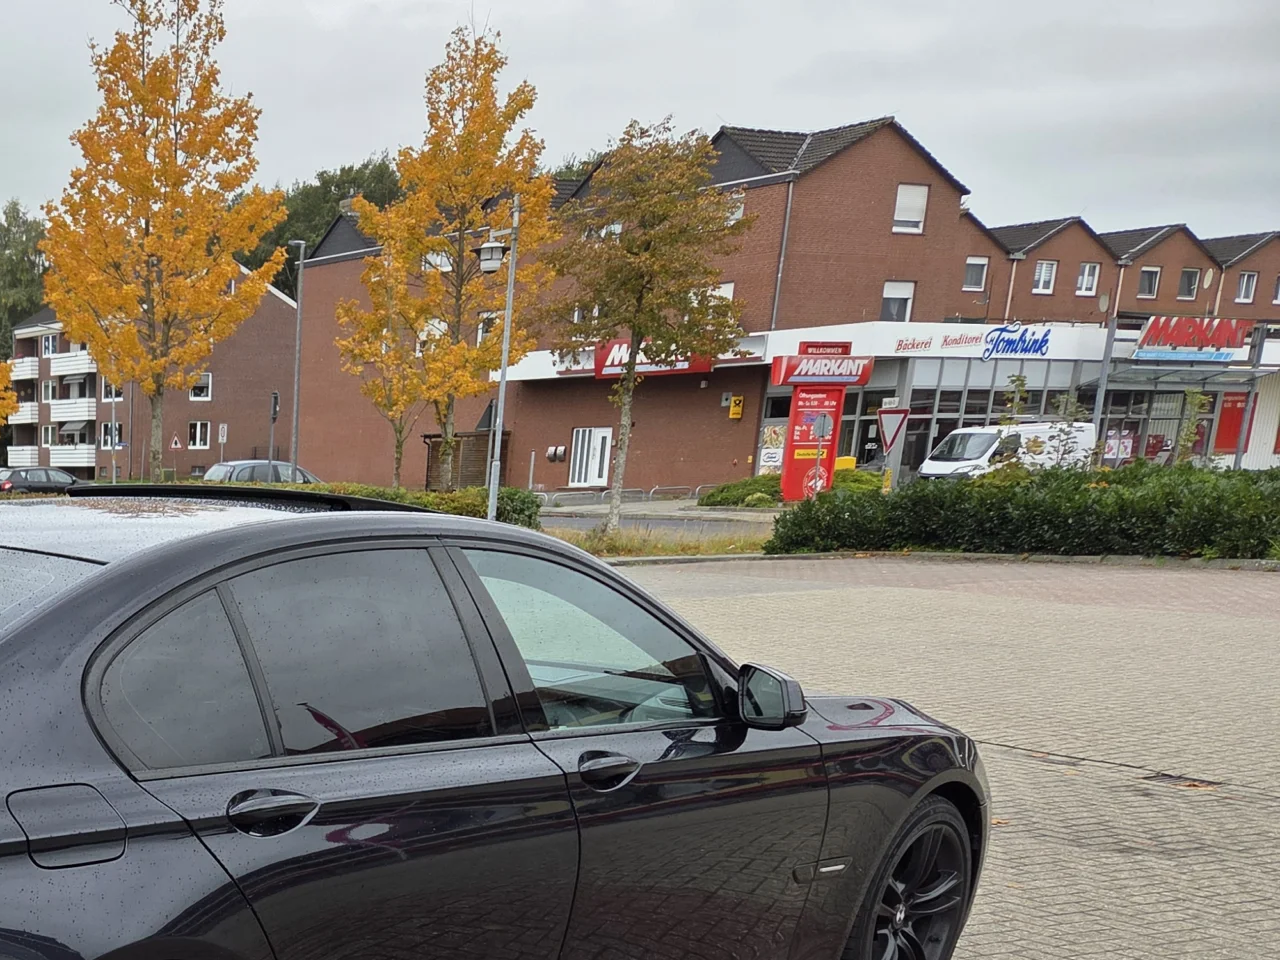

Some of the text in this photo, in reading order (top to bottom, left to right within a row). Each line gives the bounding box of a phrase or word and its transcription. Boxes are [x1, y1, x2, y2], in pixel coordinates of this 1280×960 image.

[896, 332, 984, 351] Bäckerei Konditorei
[983, 322, 1052, 360] Tombrink
[1139, 316, 1257, 348] MARKANT
[793, 359, 869, 375] MARKANT
